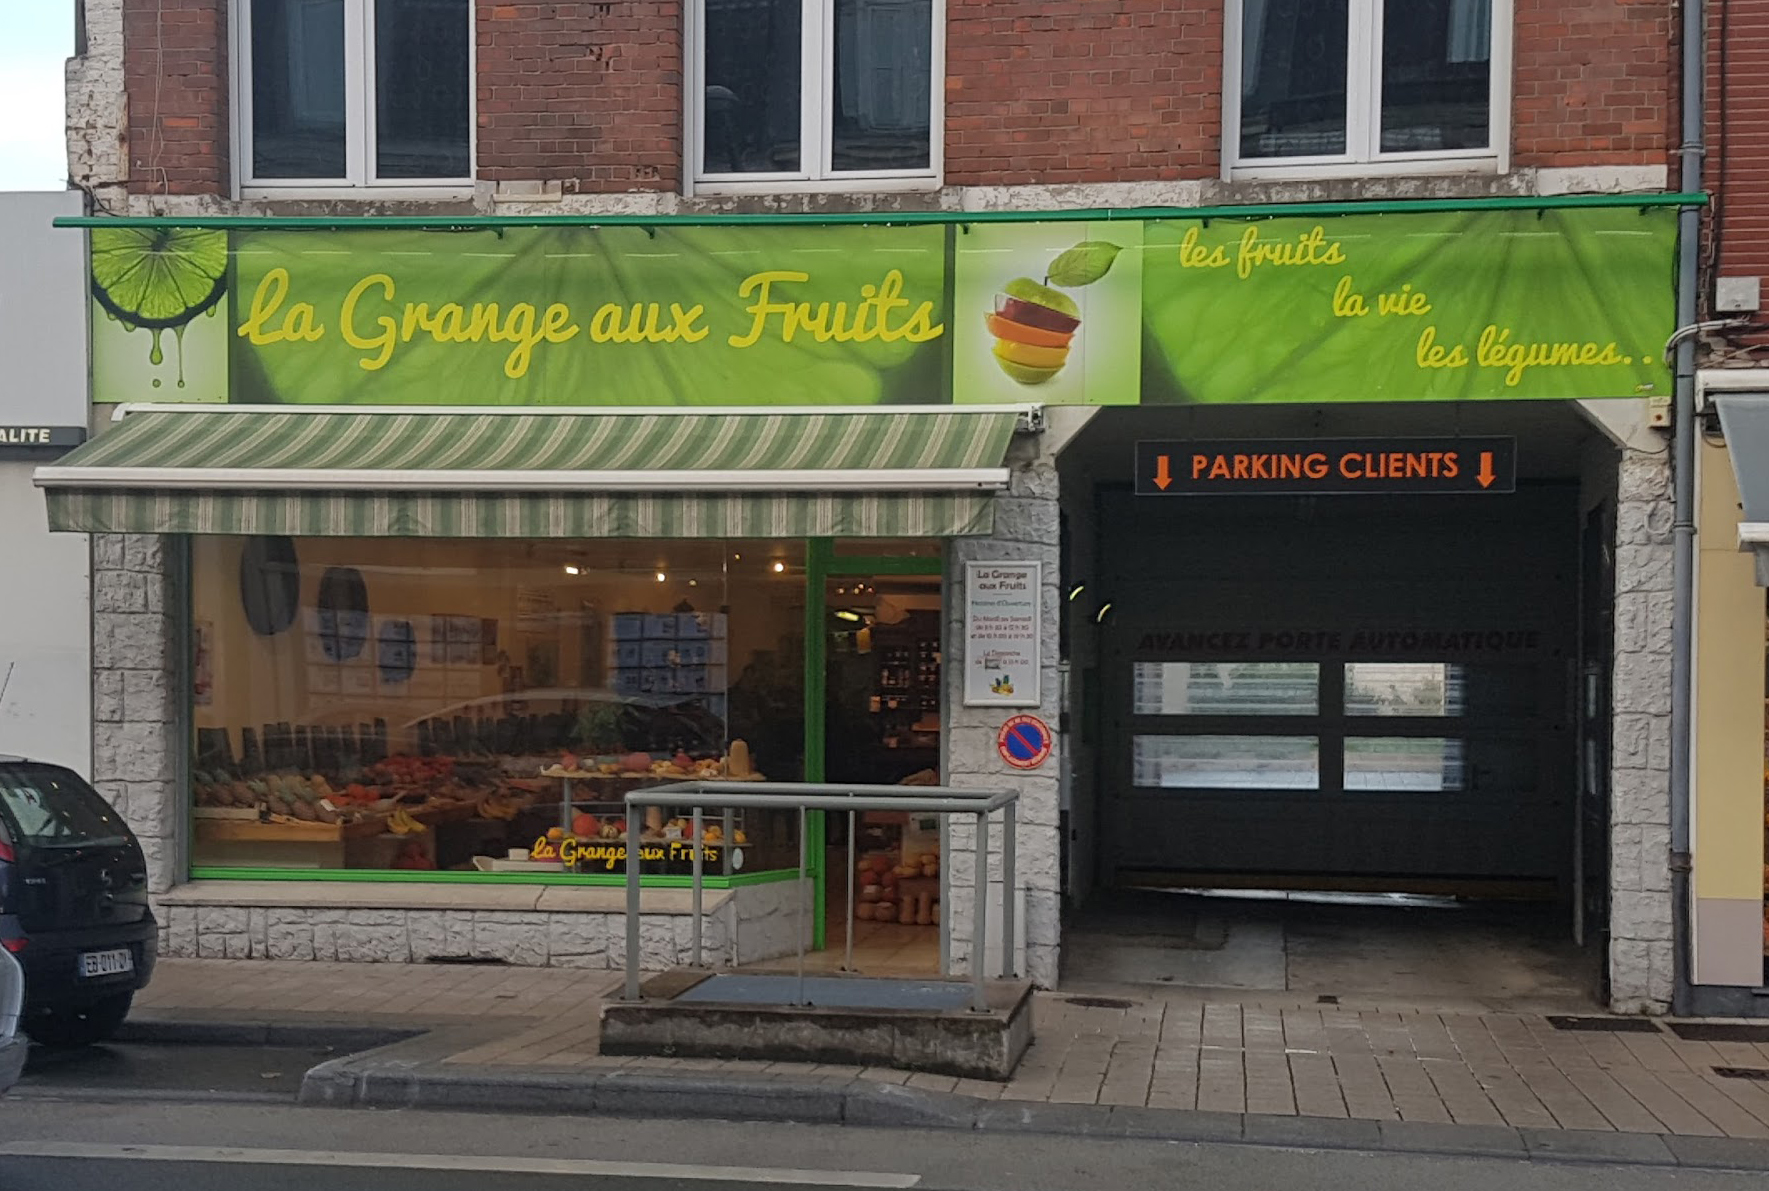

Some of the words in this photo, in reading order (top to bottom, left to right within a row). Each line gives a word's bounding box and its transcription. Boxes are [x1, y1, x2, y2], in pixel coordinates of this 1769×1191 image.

[1179, 226, 1231, 267] les
[1237, 225, 1347, 279] fruits
[1332, 275, 1370, 317] la
[1378, 284, 1432, 315] vie
[340, 274, 580, 378] Grange
[590, 302, 709, 343] aux
[728, 269, 944, 347] Fruits
[1416, 325, 1469, 368] les
[0, 427, 51, 443] ALITE
[1191, 453, 1329, 479] PARKING
[1339, 452, 1459, 478] CLIENTS
[1138, 632, 1251, 652] AVANCEZ
[1257, 632, 1342, 652] PORTE
[1349, 630, 1541, 652] AUTOMATIQUE
[559, 838, 628, 870] Grange
